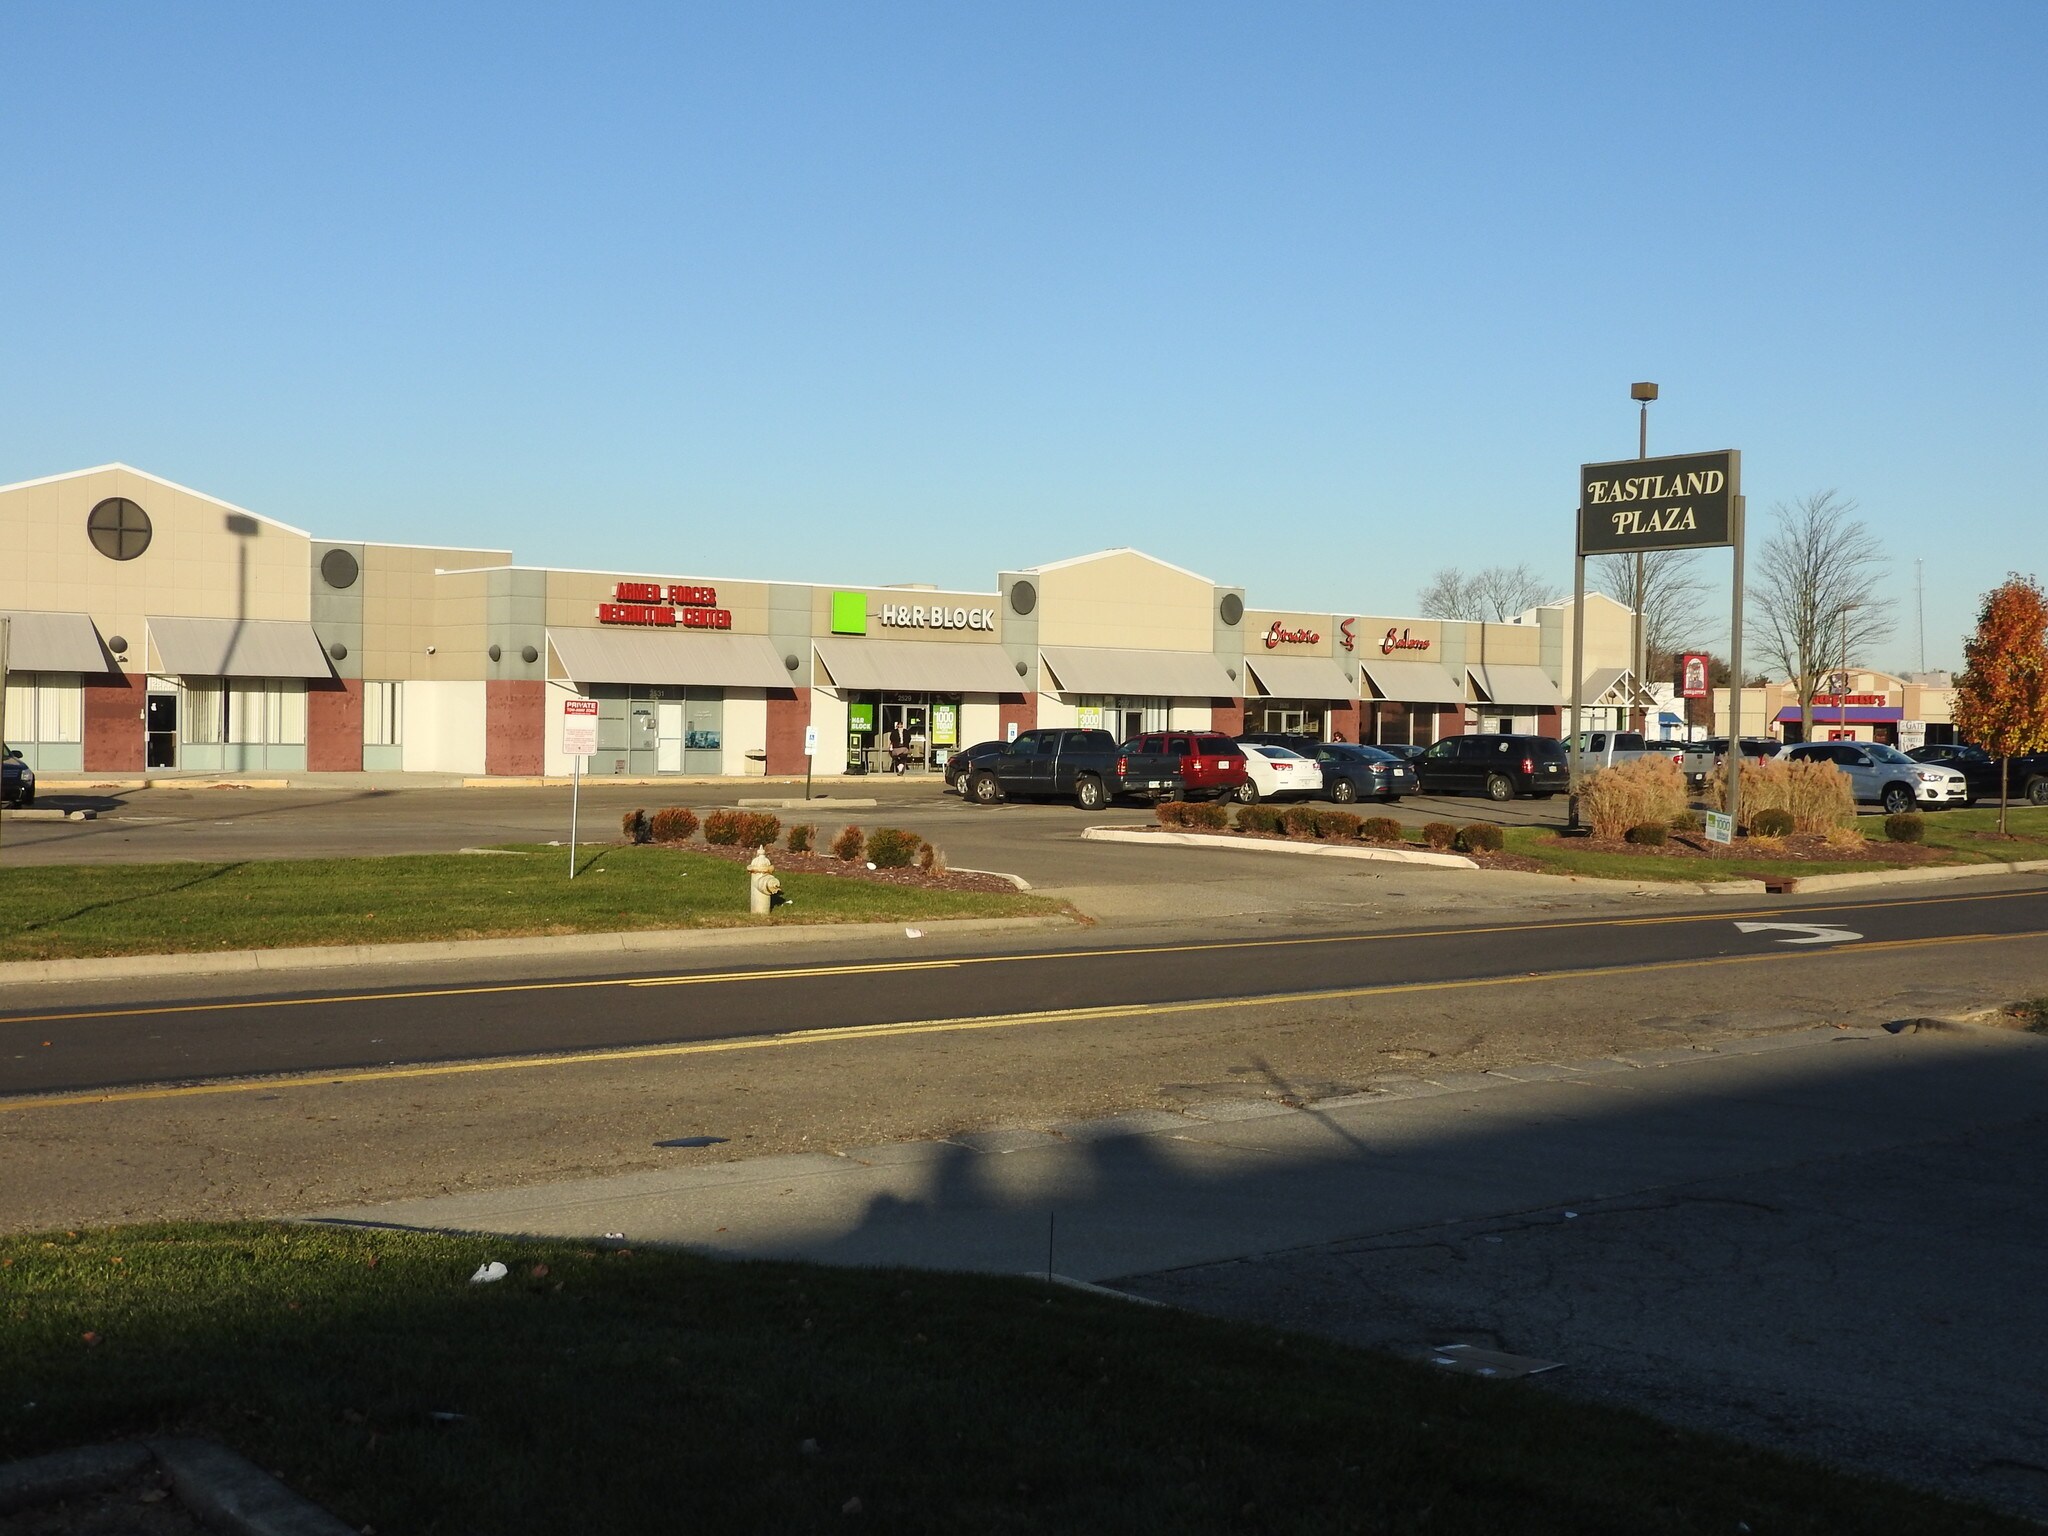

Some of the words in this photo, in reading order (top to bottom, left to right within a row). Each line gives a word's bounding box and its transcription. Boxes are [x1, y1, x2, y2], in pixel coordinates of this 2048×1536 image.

[1587, 470, 1724, 504] EASTLAND
[1611, 506, 1697, 535] PLAZA
[616, 582, 661, 604] ARMED
[667, 585, 716, 607] FORCES
[599, 603, 676, 627] RECRUITING
[683, 608, 731, 630] CENTER
[881, 603, 925, 628] H&R
[929, 606, 995, 631] BLOCK
[566, 701, 597, 709] PRIVATE
[1905, 721, 1925, 730] GATE
